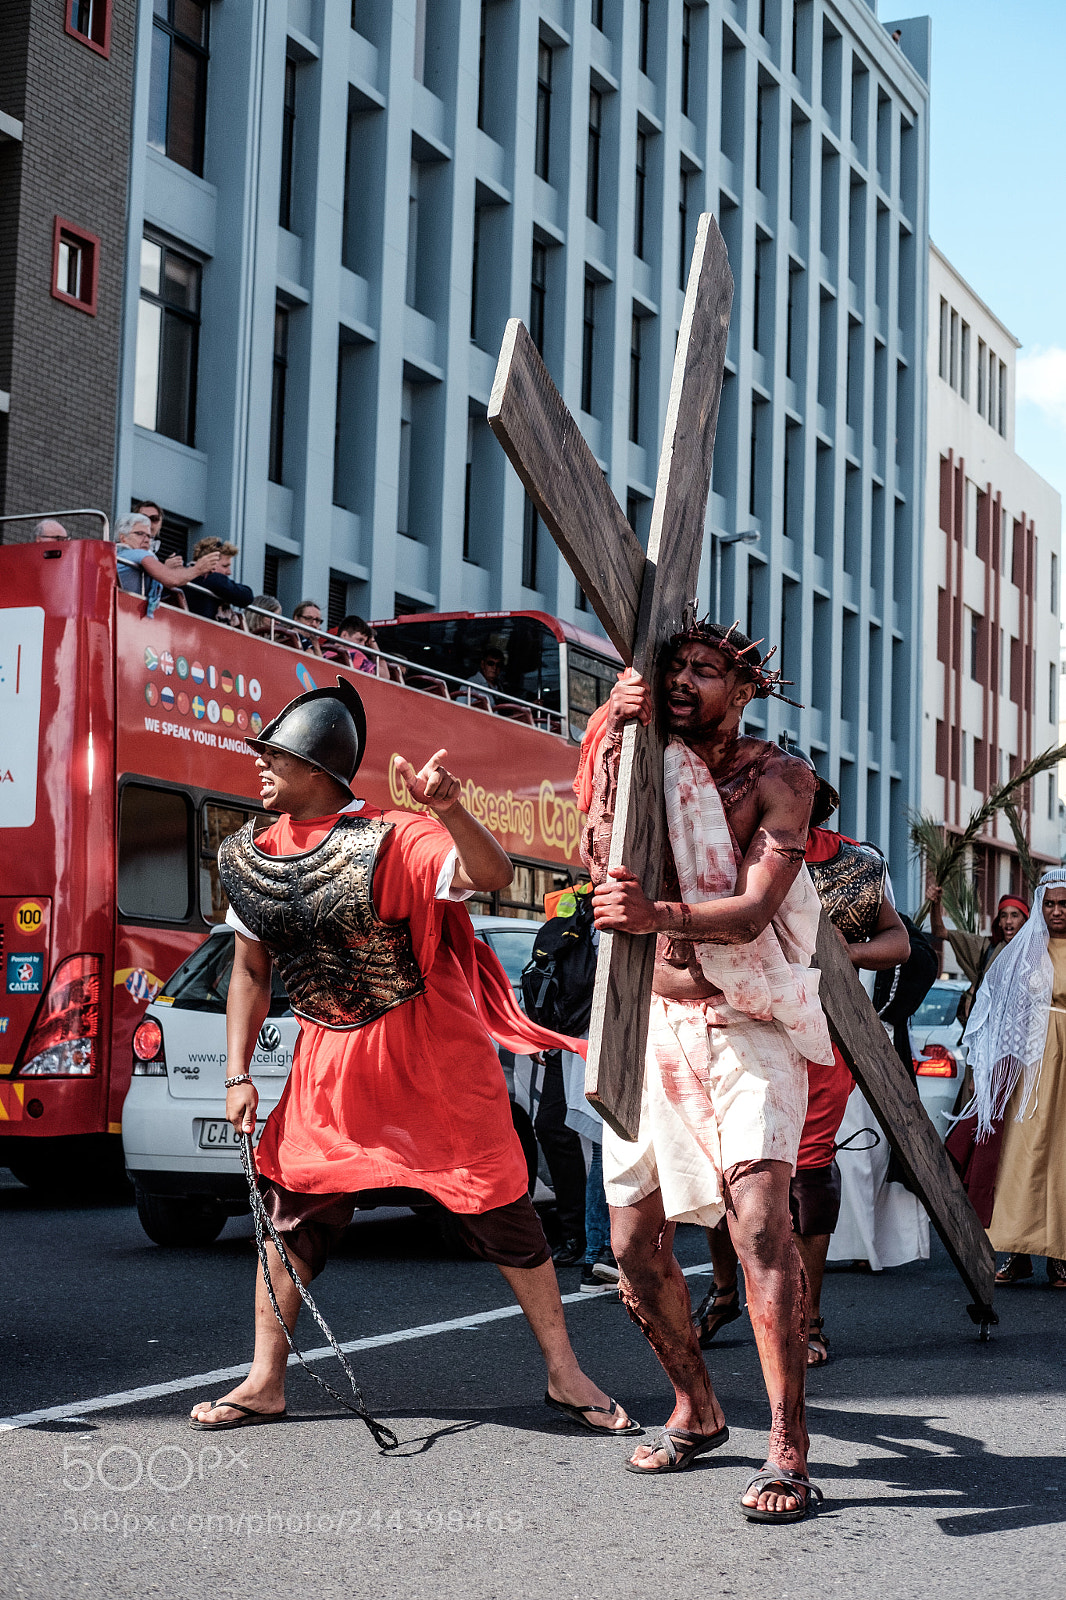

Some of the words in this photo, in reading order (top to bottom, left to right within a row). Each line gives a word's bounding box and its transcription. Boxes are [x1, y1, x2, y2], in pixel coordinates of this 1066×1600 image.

[144, 717, 160, 733] WE
[162, 721, 191, 741] SPEAK
[192, 729, 217, 747] YOUR
[19, 909, 41, 925] 100
[9, 982, 40, 992] CALTEX
[173, 1066, 200, 1074] POLO
[207, 1124, 228, 1143] CA
